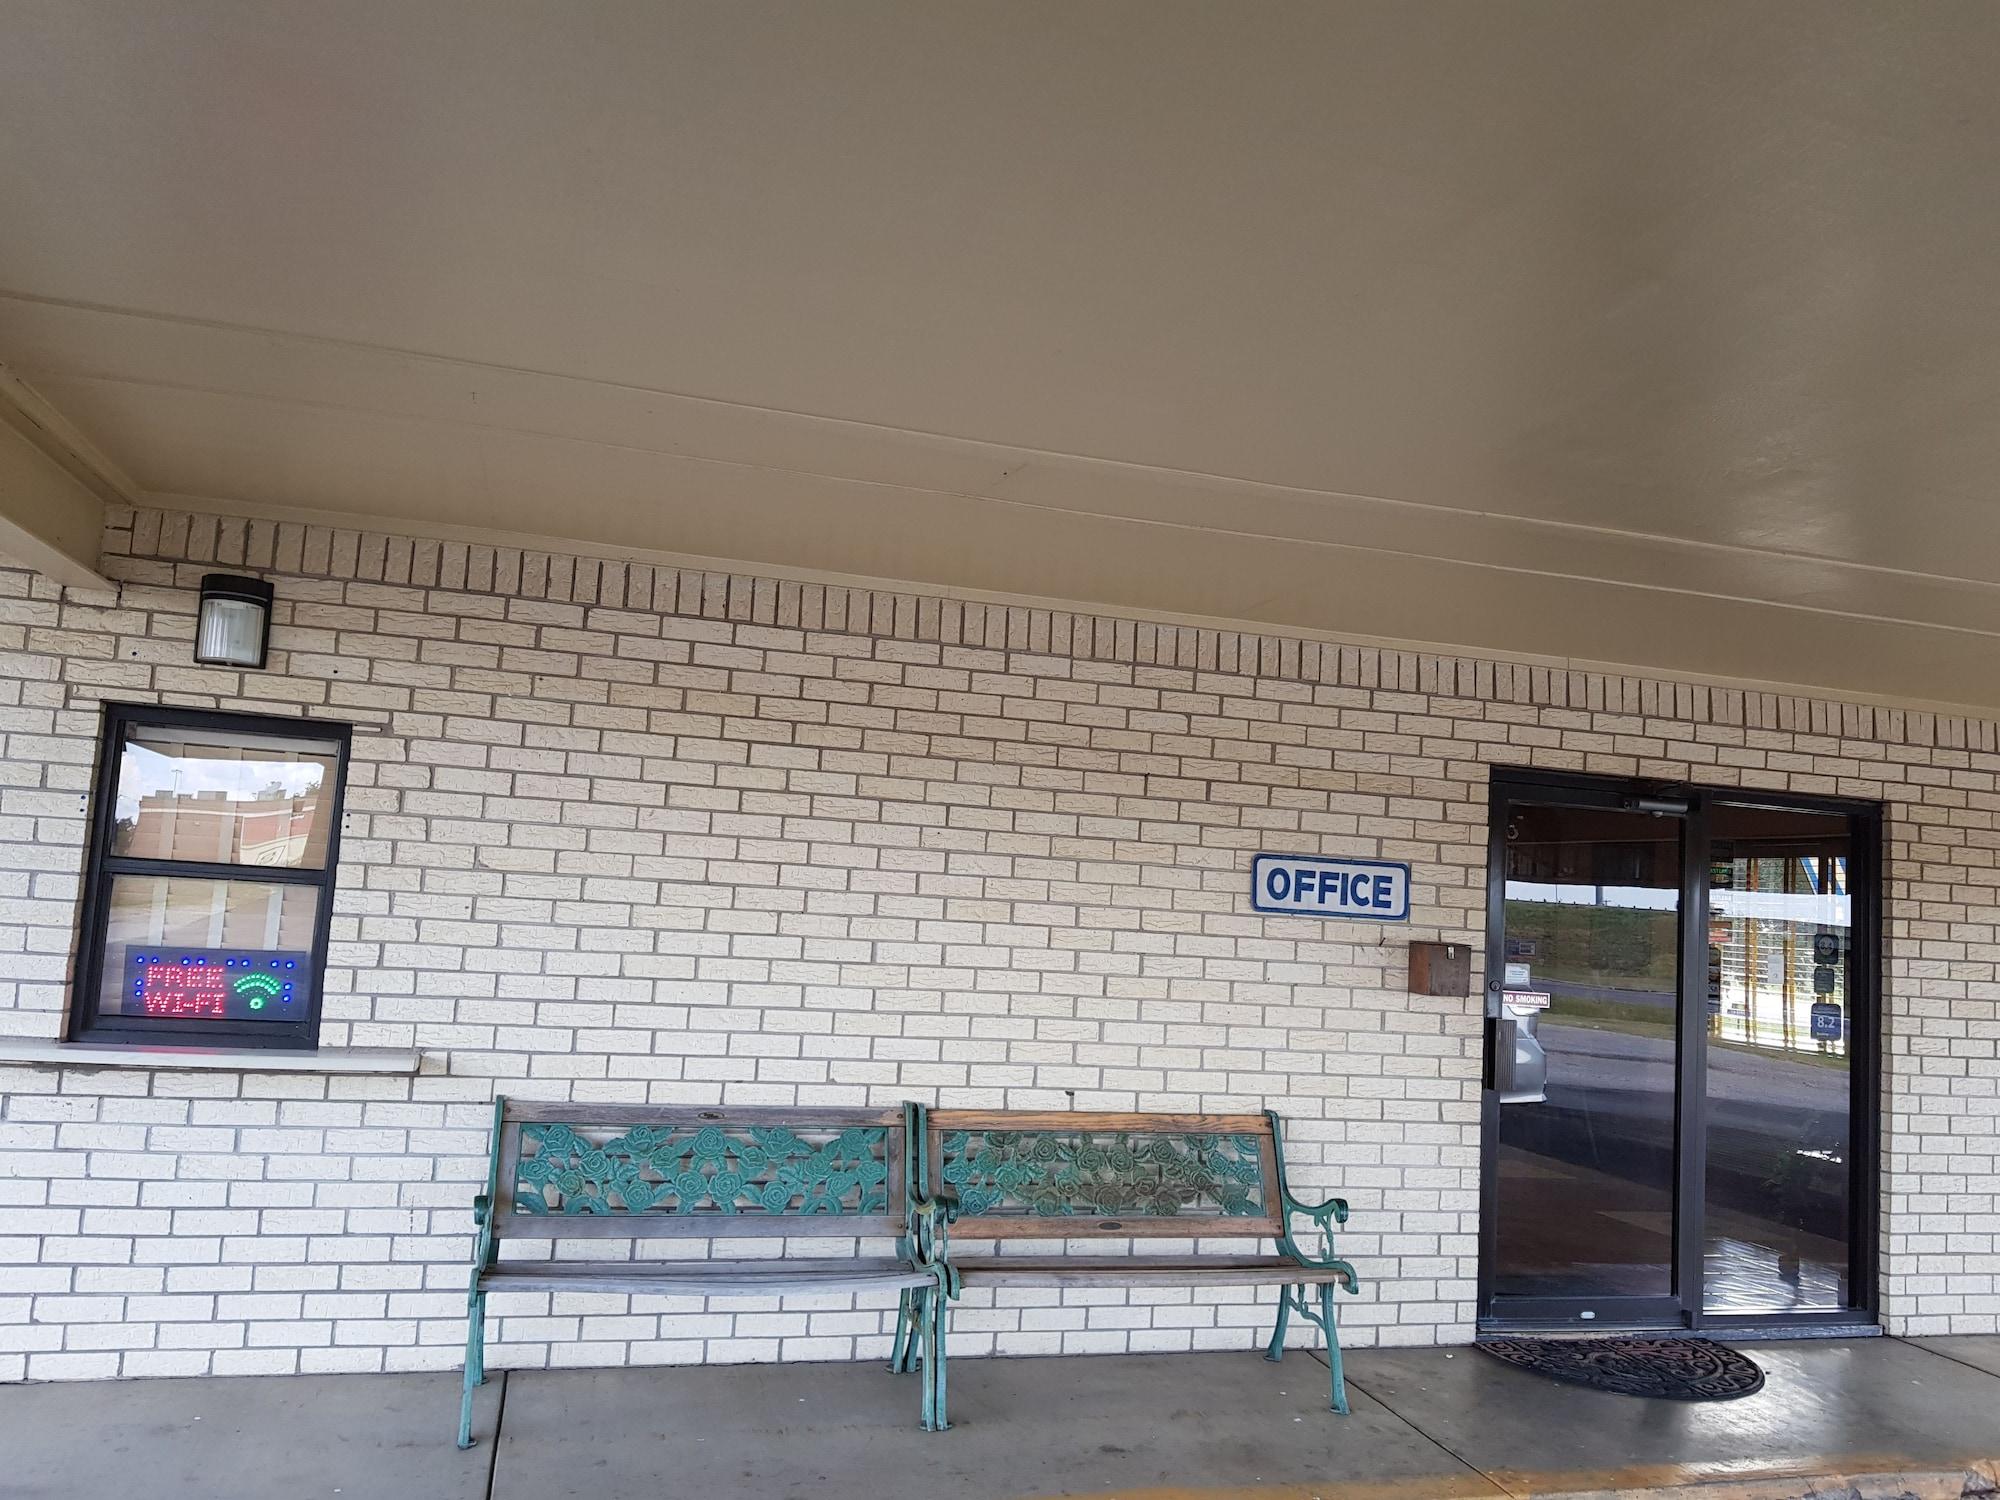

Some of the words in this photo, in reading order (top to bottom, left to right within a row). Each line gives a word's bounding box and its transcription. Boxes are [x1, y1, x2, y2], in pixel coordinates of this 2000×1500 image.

[1266, 867, 1393, 909] OFFICE
[147, 967, 223, 987] FREE
[144, 992, 224, 1013] WI-FI
[1503, 994, 1514, 1003] NO
[1515, 994, 1548, 1005] SMOKING
[1817, 1016, 1836, 1029] 8.2
